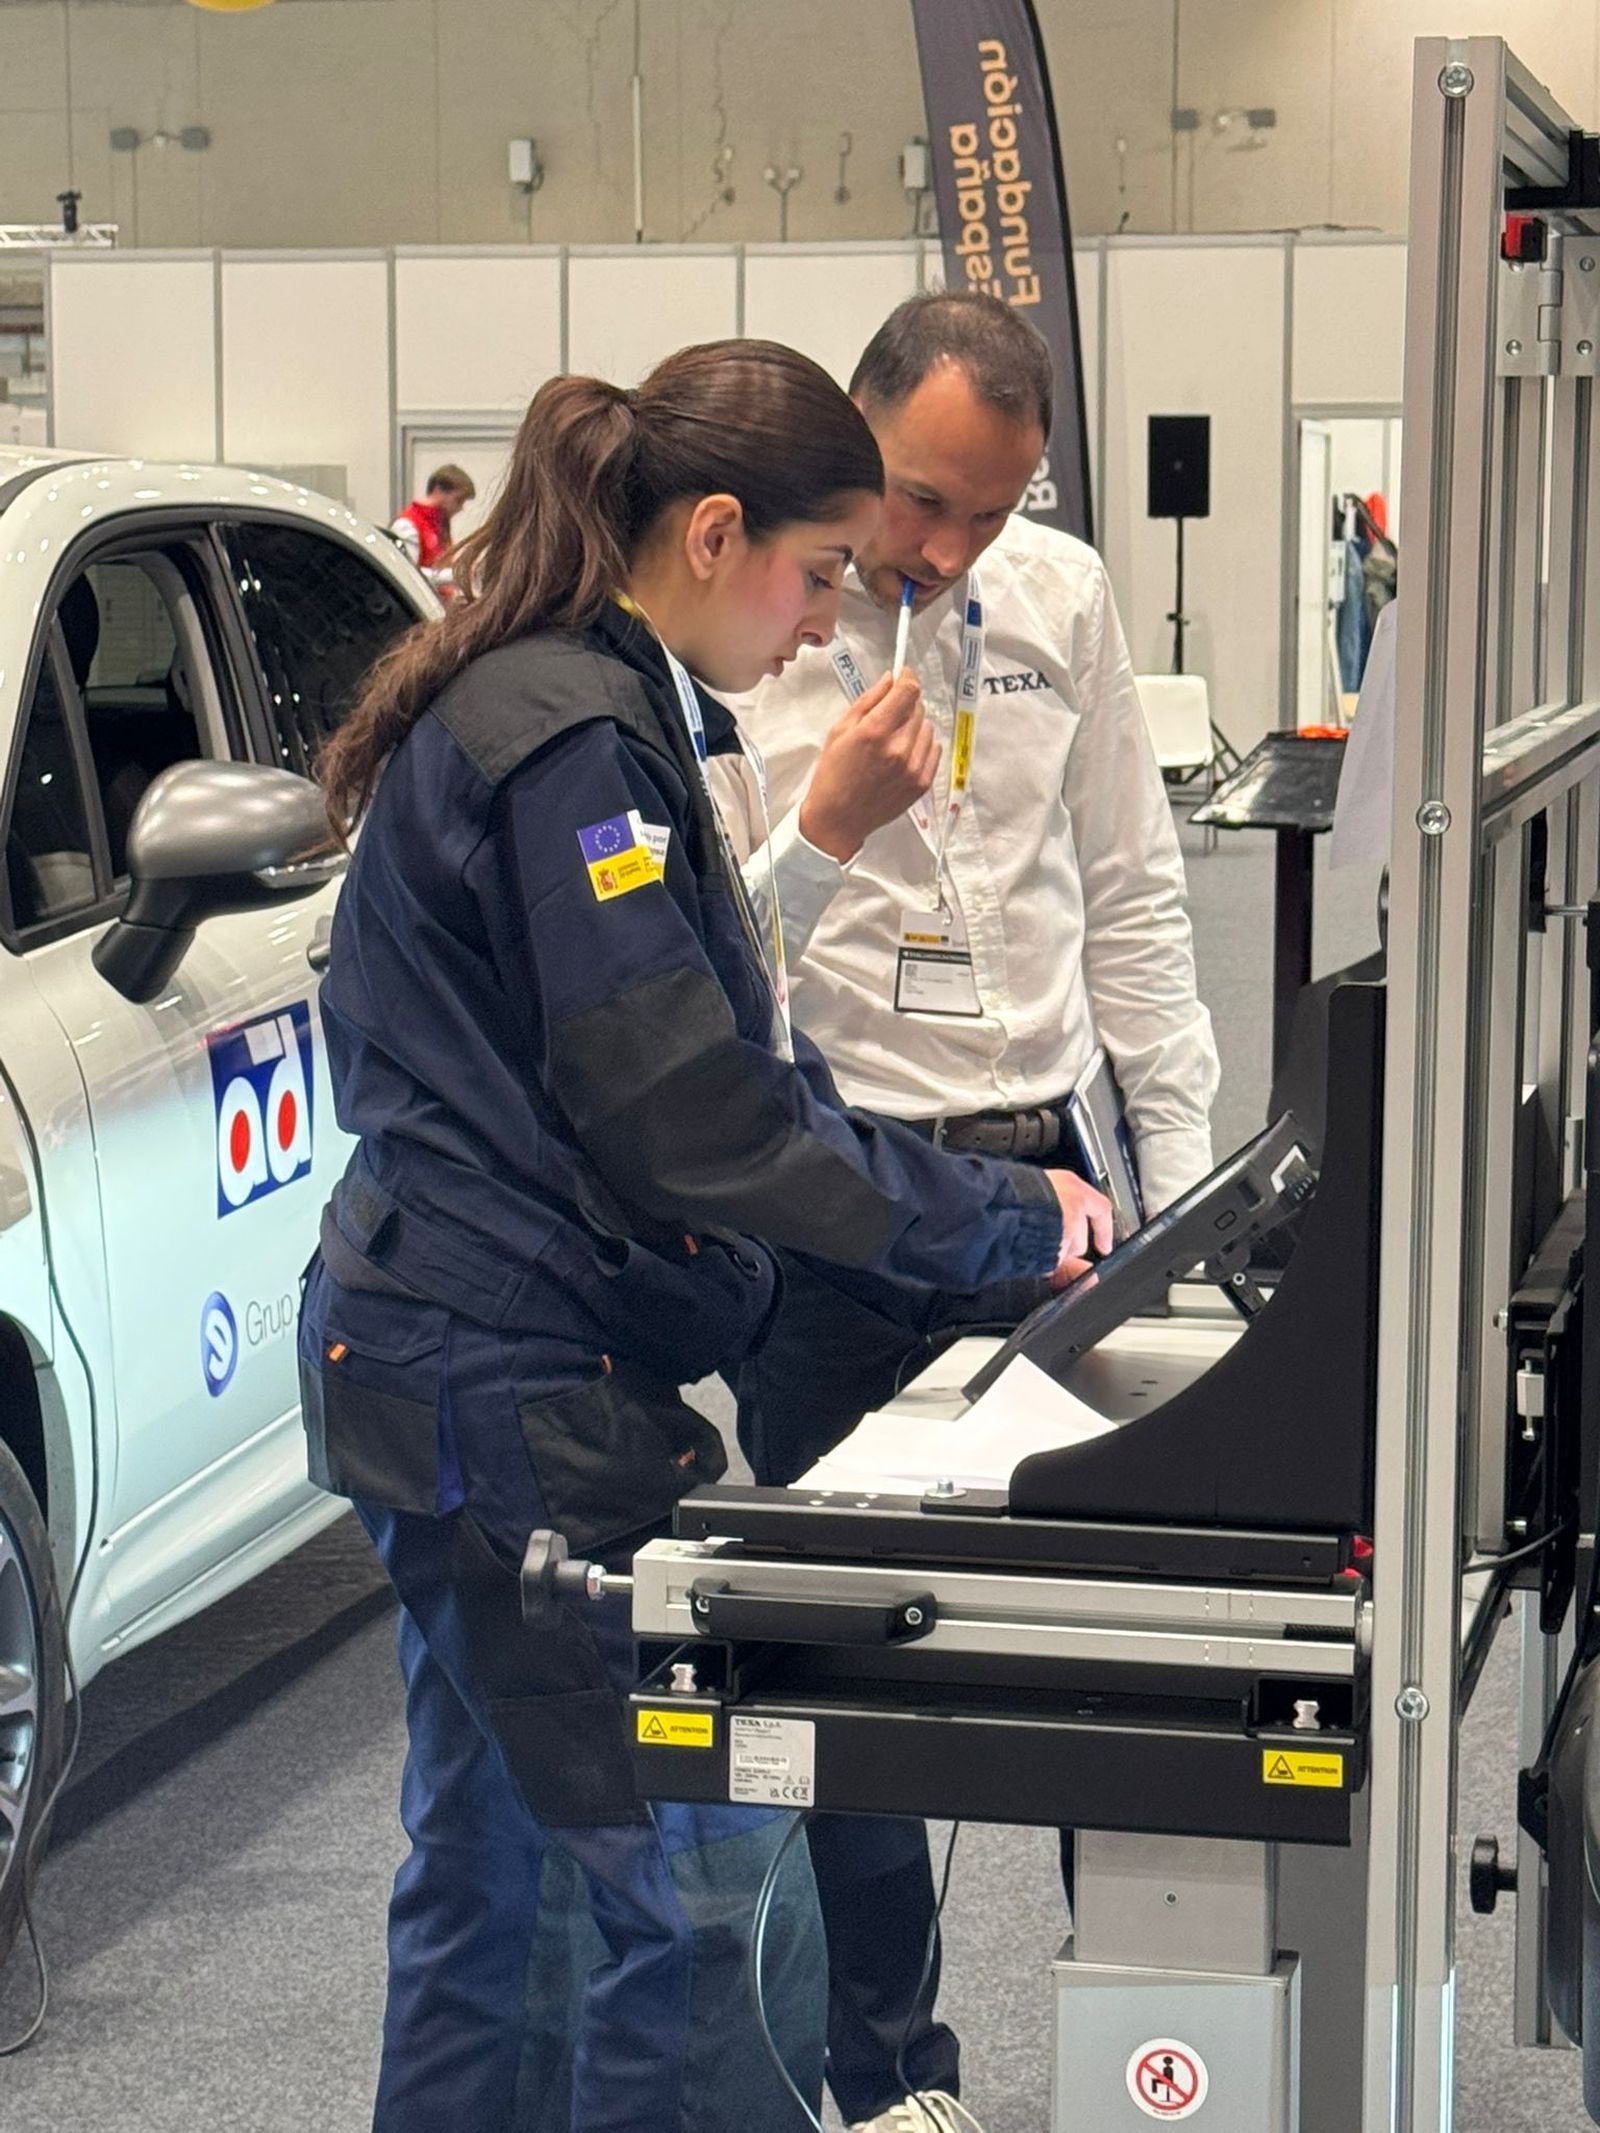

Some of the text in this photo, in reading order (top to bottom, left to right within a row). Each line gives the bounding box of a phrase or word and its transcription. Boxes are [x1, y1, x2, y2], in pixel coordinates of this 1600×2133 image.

[984, 671, 1052, 695] TEXA
[670, 1725, 709, 1735] ATTENTION
[1297, 1765, 1339, 1775] ATTENTION
